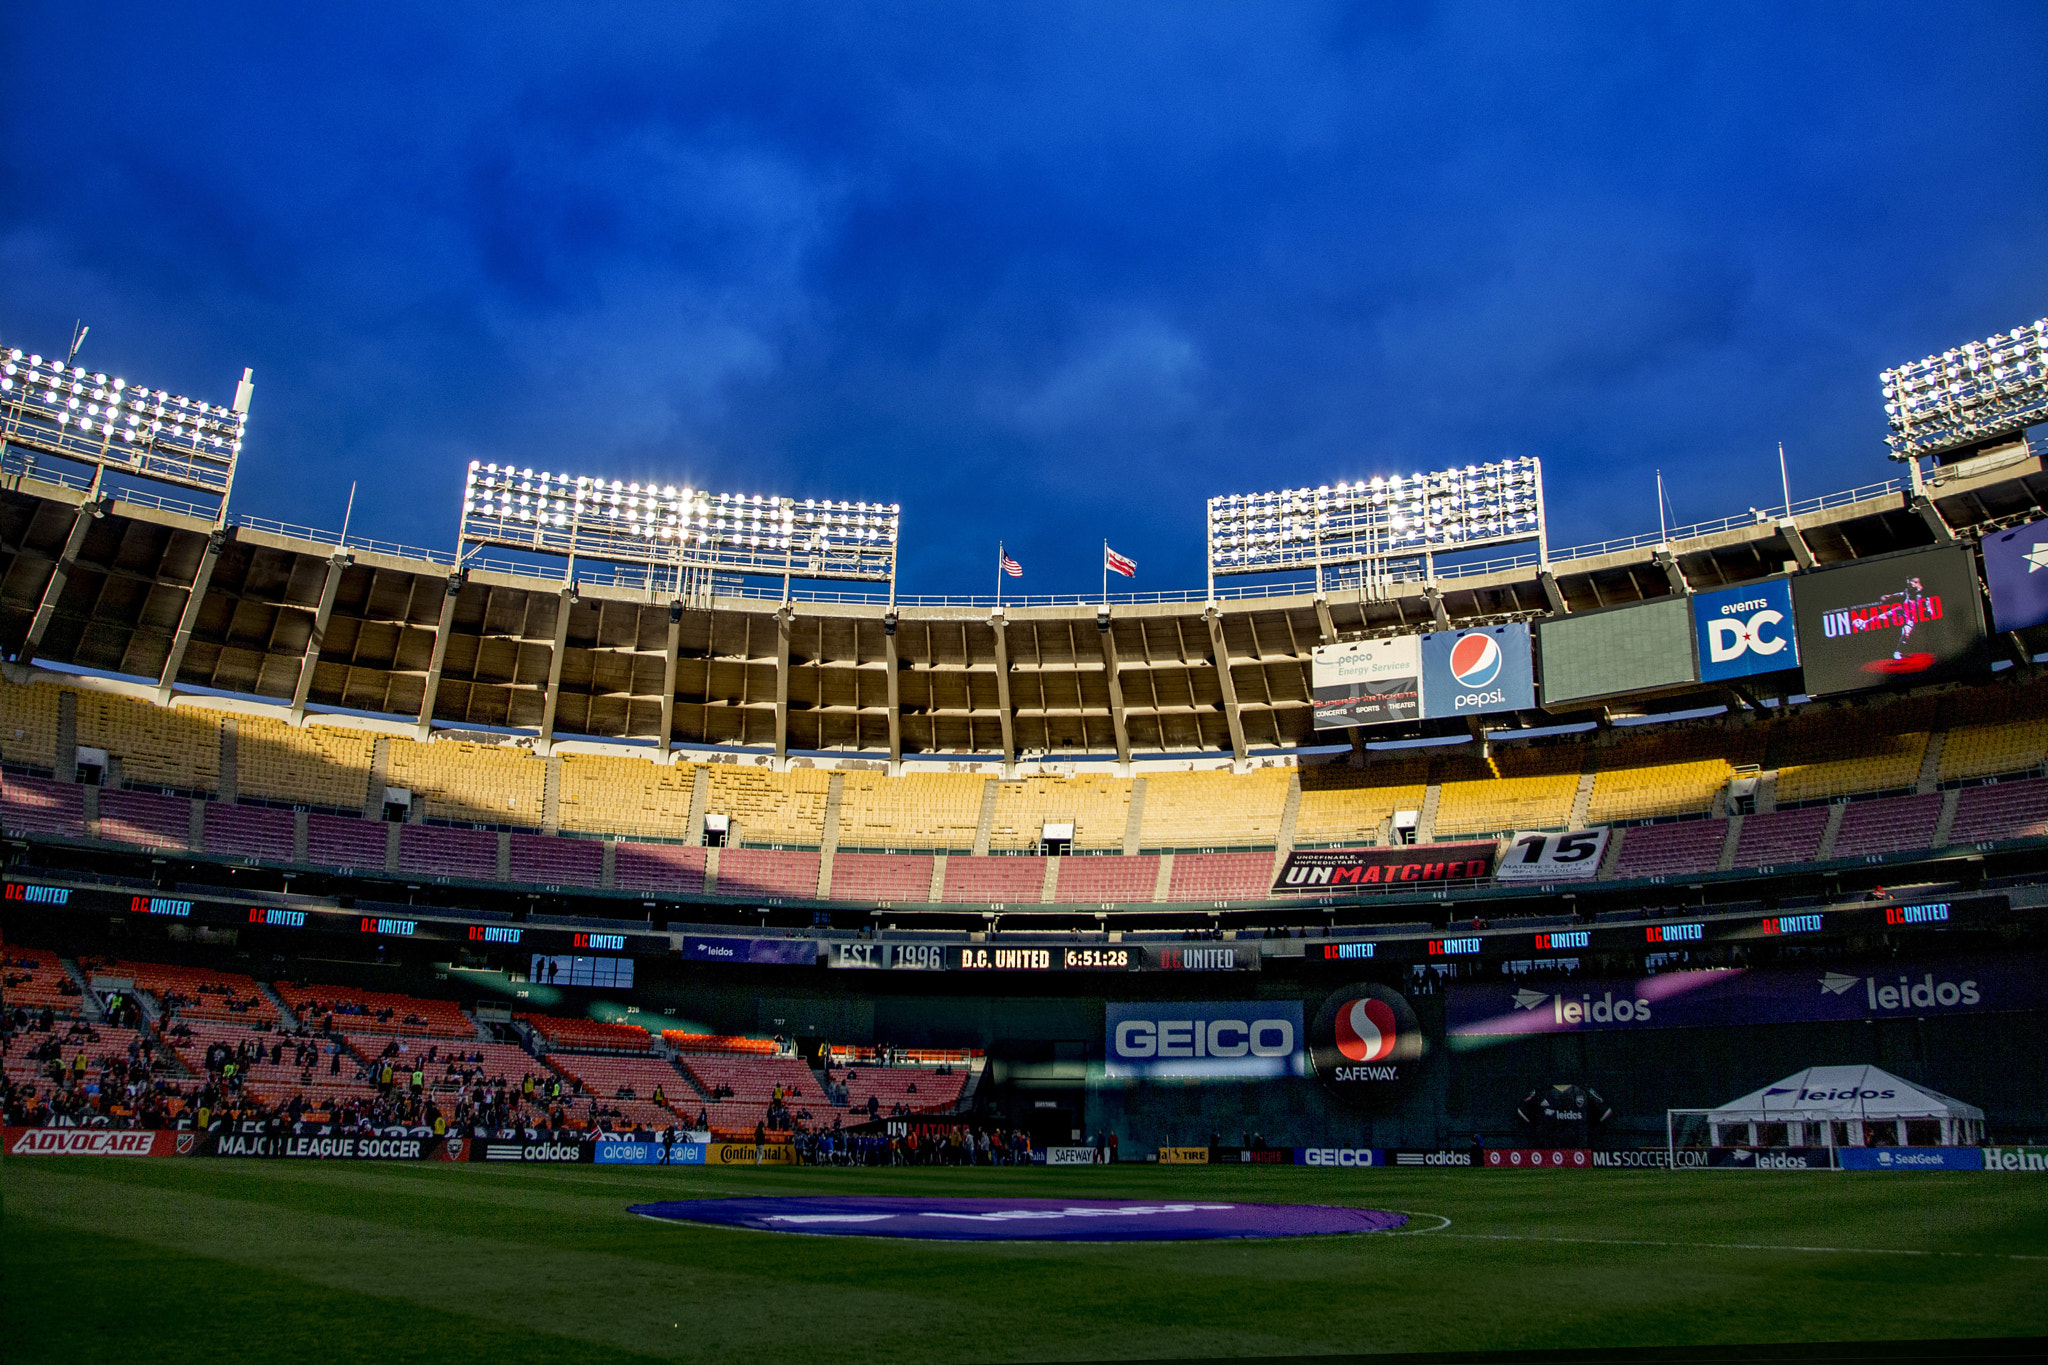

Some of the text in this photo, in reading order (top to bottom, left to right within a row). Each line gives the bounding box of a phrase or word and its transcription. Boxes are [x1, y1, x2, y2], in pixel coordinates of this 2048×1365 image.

[1721, 598, 1768, 615] events
[1822, 596, 1943, 638] UNMATCHED
[1338, 653, 1373, 666] pepco
[1338, 661, 1411, 676] Energy Services
[1455, 688, 1501, 710] pepsi
[1316, 701, 1416, 718] CONCERTS SPORTS THEATER
[1517, 832, 1600, 863] 15
[1285, 859, 1487, 885] UNMATCHED
[708, 945, 734, 957] leidos
[840, 945, 941, 970] EST 1996
[962, 950, 1050, 969] D.C. UNITED
[1067, 951, 1128, 967] 6:51:28
[1866, 973, 1981, 1011] leidos
[1554, 991, 1652, 1024] leidos
[1115, 1019, 1294, 1058] GEICO
[1335, 1066, 1397, 1081] SAFEWAY
[1799, 1087, 1895, 1102] leidos
[1556, 1108, 1583, 1121] leidos
[15, 1131, 153, 1152] ADVOCARE
[286, 1137, 353, 1157] LEAGUE
[358, 1140, 421, 1159] SOCCER
[524, 1142, 580, 1161] adidas
[604, 1145, 648, 1160] alcatel
[720, 1145, 781, 1163] Continntal
[1055, 1149, 1092, 1162] SAFEWAY
[1182, 1151, 1206, 1161] TIRE
[1305, 1148, 1373, 1167] GEICO
[1425, 1151, 1471, 1166] adidas
[1895, 1153, 1945, 1165] SeatGeek
[1755, 1152, 1808, 1169] leidos
